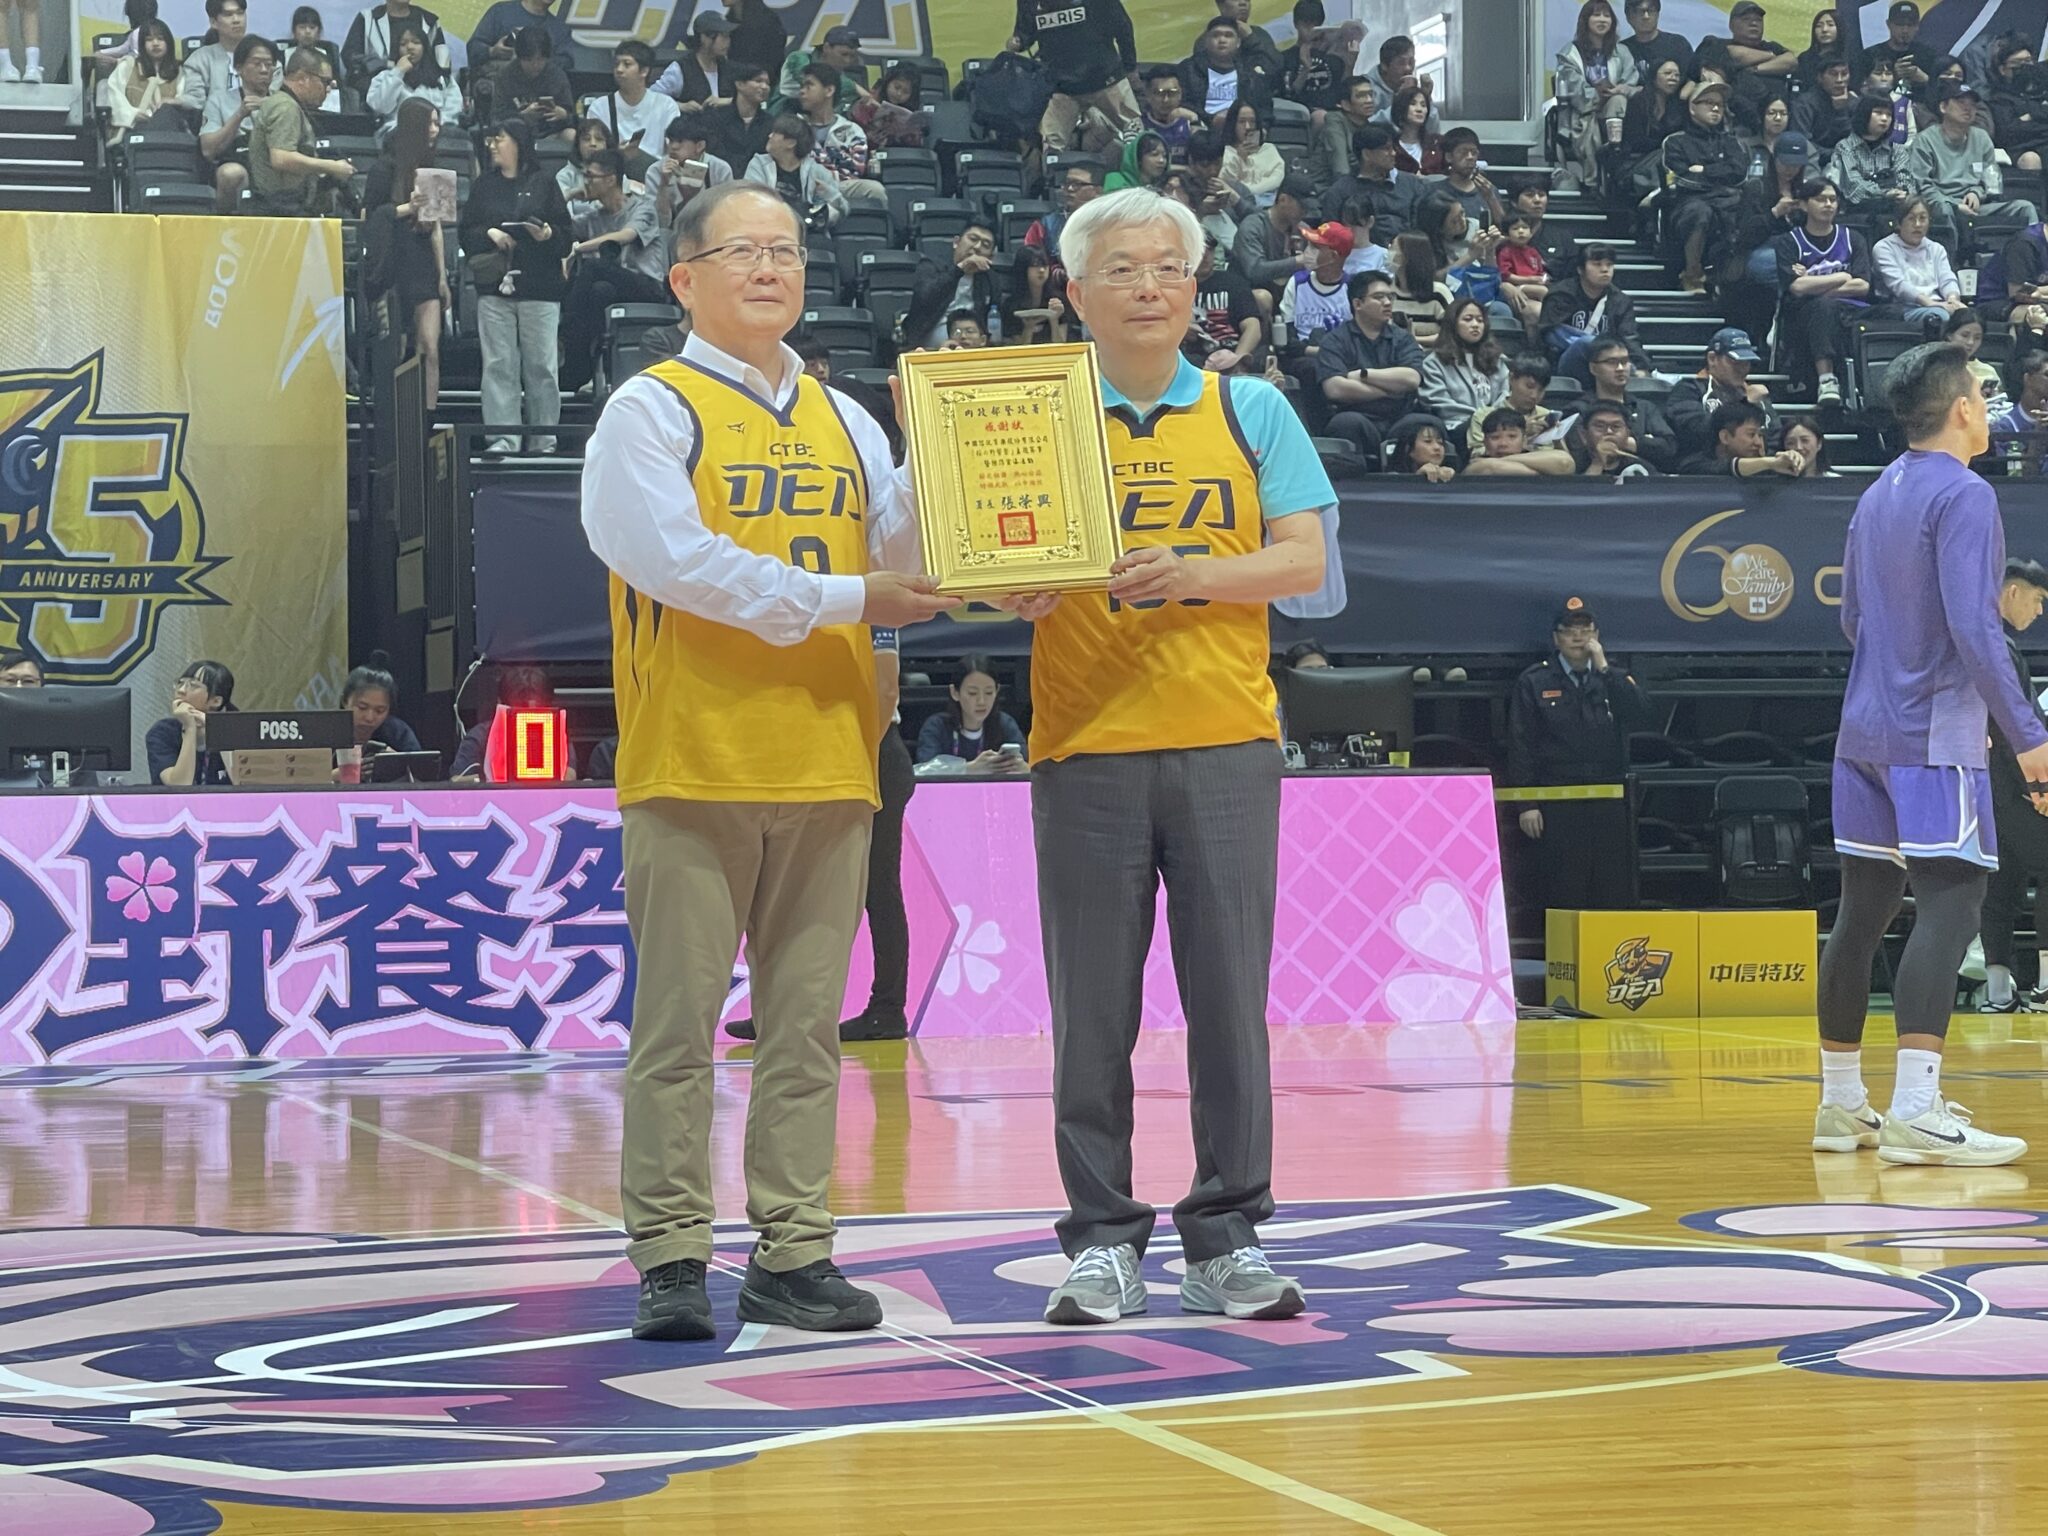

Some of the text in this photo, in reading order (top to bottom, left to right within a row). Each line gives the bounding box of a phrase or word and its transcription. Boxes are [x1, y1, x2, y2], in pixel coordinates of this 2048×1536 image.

[1112, 461, 1174, 476] CTBC
[19, 572, 154, 588] ANNIVERSARY
[260, 721, 303, 740] POSS.
[516, 712, 554, 778] 0
[1709, 962, 1807, 983] 中信特攻
